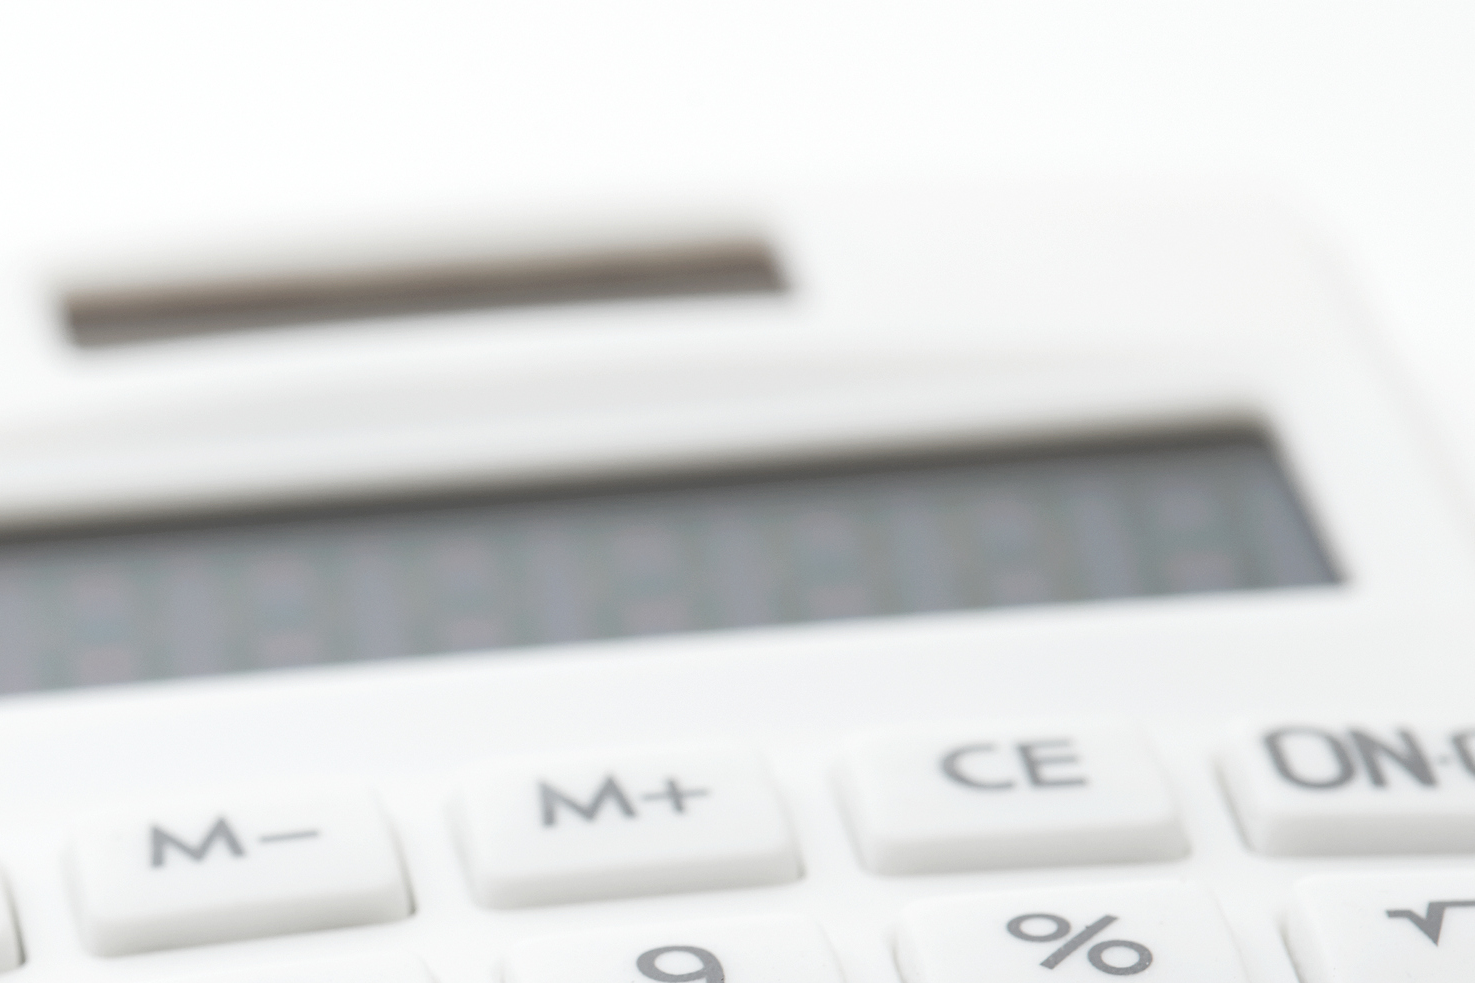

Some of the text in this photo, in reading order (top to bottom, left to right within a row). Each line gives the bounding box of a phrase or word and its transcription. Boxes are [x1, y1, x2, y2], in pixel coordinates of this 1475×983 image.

[936, 736, 1089, 793] CE
[537, 773, 711, 831] M+
[1004, 911, 1155, 977] %
